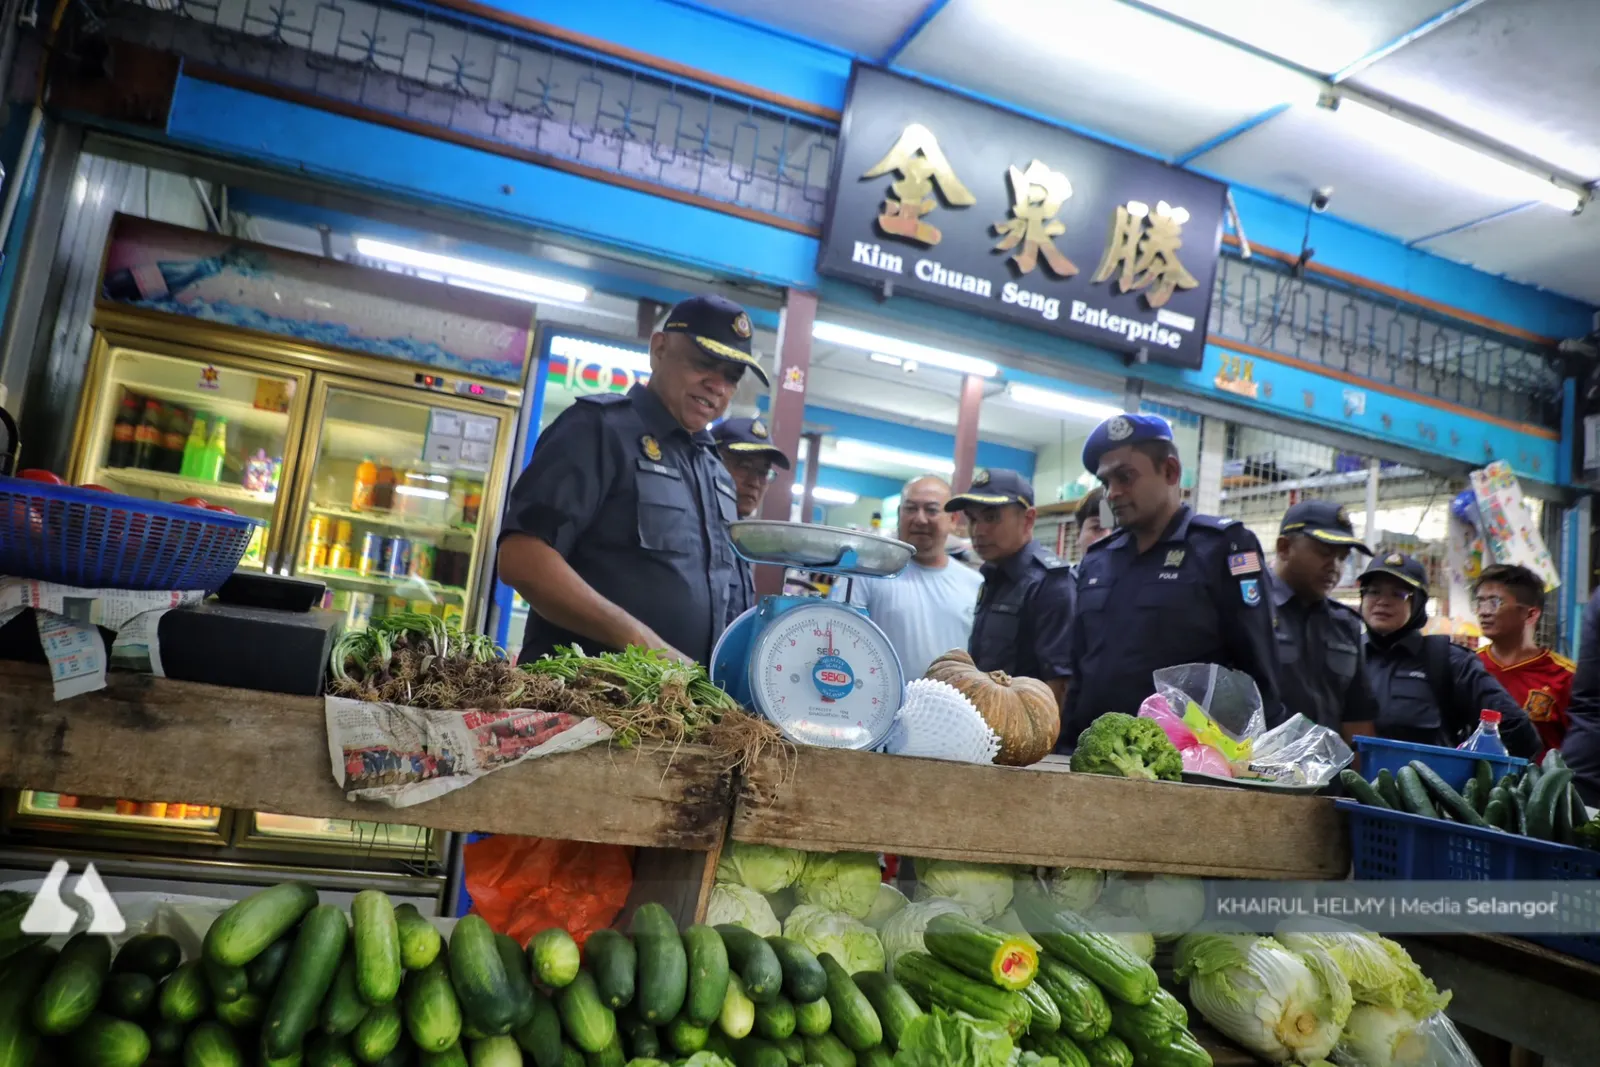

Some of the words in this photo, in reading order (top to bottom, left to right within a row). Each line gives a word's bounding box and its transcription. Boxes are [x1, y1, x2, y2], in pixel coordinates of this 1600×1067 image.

[862, 123, 1199, 308] 金泉勝
[852, 241, 903, 273] Kim
[915, 258, 992, 297] Chuan
[1002, 281, 1061, 320] Seng
[1070, 299, 1182, 349] Enterprise
[776, 664, 783, 672] 8
[869, 667, 876, 675] 2
[821, 671, 846, 683] SEKO
[872, 697, 878, 705] 3
